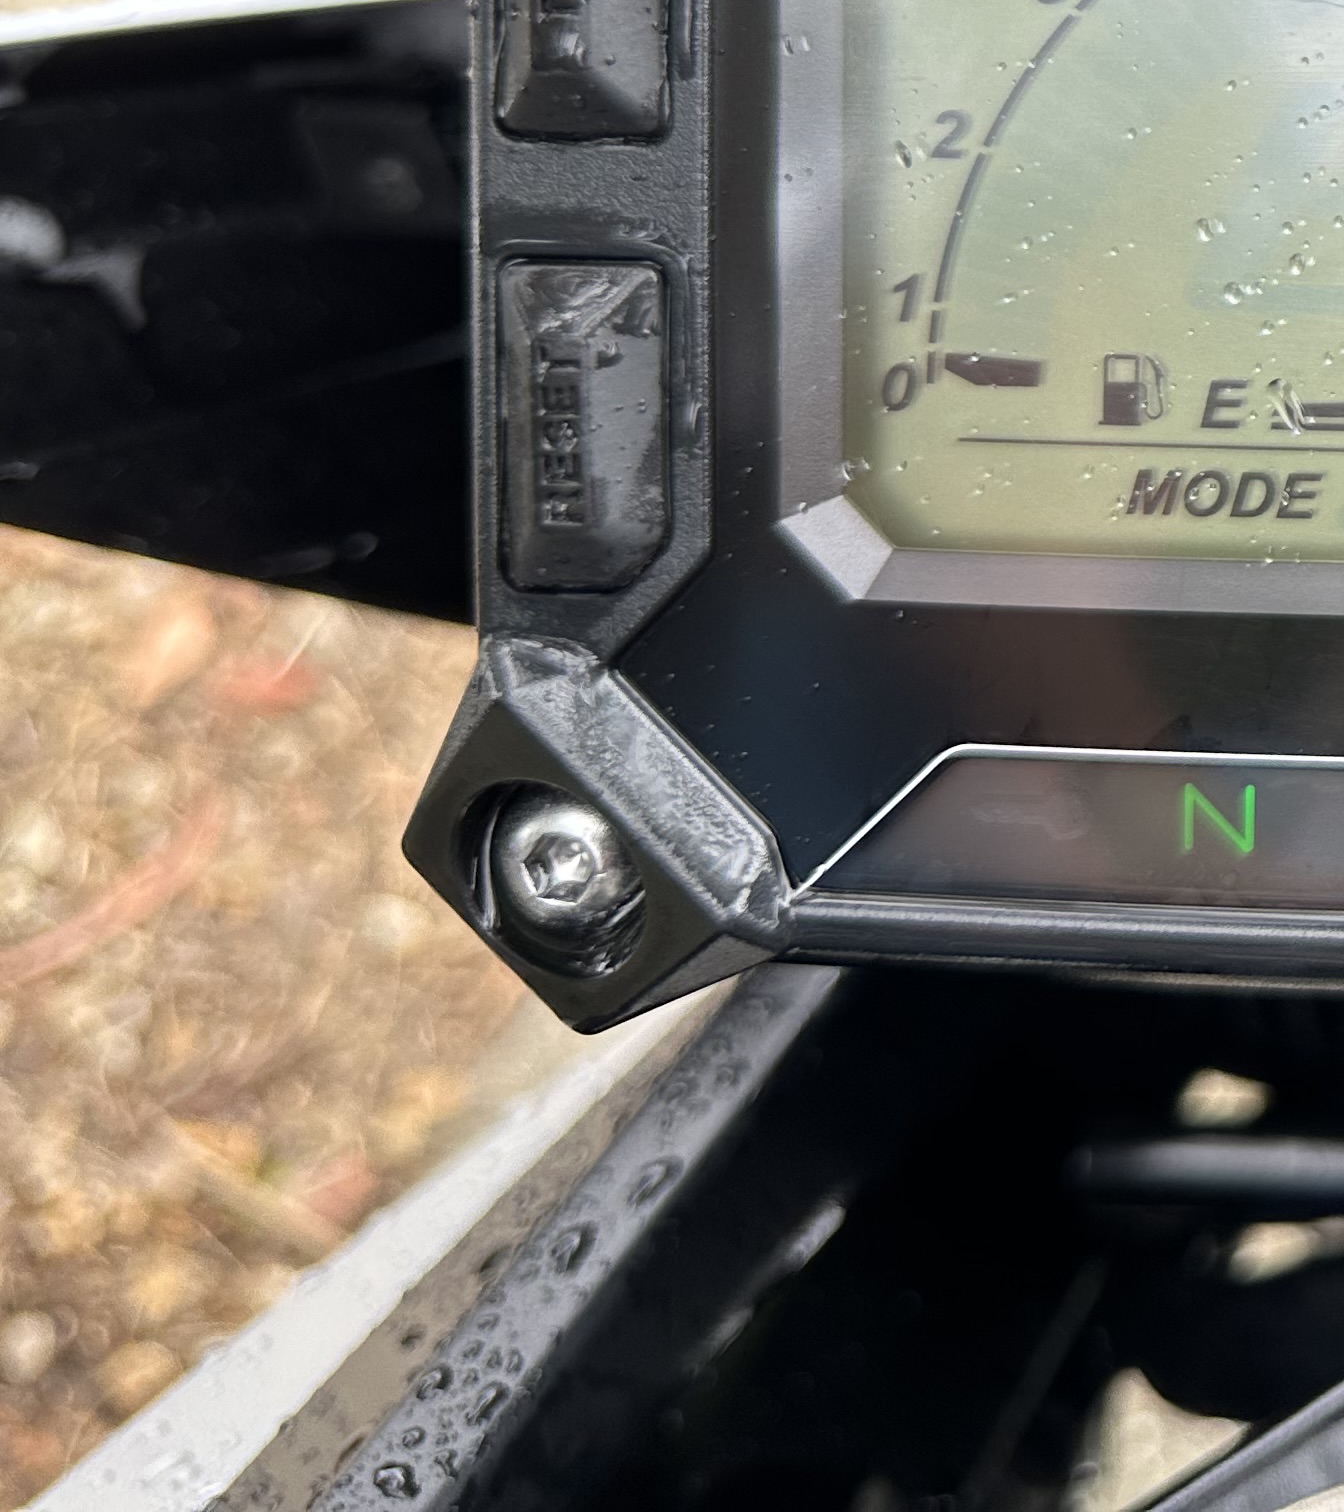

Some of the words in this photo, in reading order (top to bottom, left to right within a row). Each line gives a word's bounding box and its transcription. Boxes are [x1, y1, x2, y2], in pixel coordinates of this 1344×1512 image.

[931, 108, 972, 160] 2
[893, 273, 925, 323] 1
[882, 362, 918, 413] 0
[1201, 378, 1251, 429] E
[1125, 467, 1327, 519] MODE
[1180, 783, 1257, 854] N
